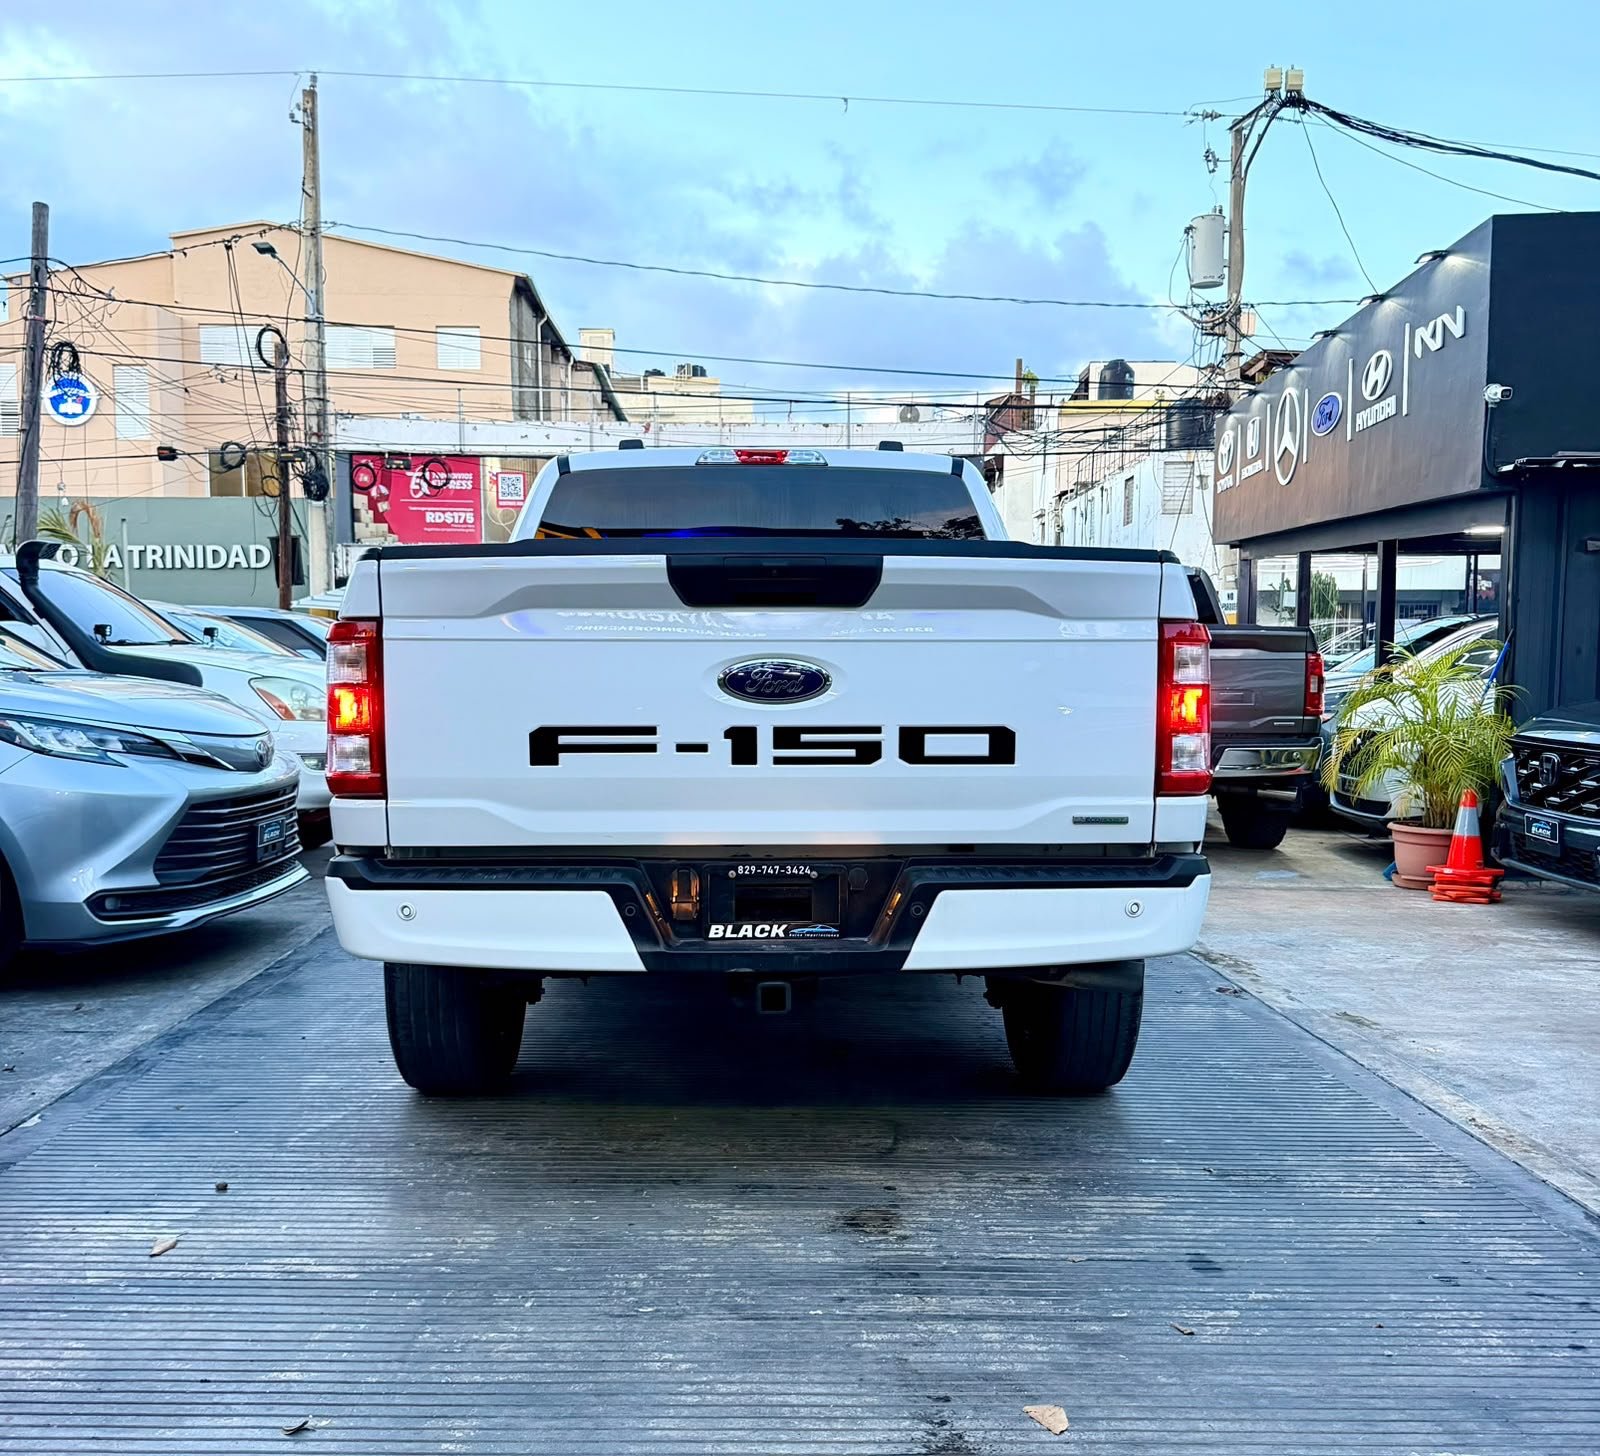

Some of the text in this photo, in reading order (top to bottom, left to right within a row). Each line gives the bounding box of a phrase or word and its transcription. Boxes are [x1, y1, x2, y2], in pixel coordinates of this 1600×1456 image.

[1356, 394, 1397, 432] HYUNDAI
[425, 511, 475, 525] RD$175
[128, 544, 272, 569] TRINIDAD
[529, 725, 1016, 766] F-150
[737, 865, 811, 875] 829-747-3424
[708, 924, 788, 938] BLACK
